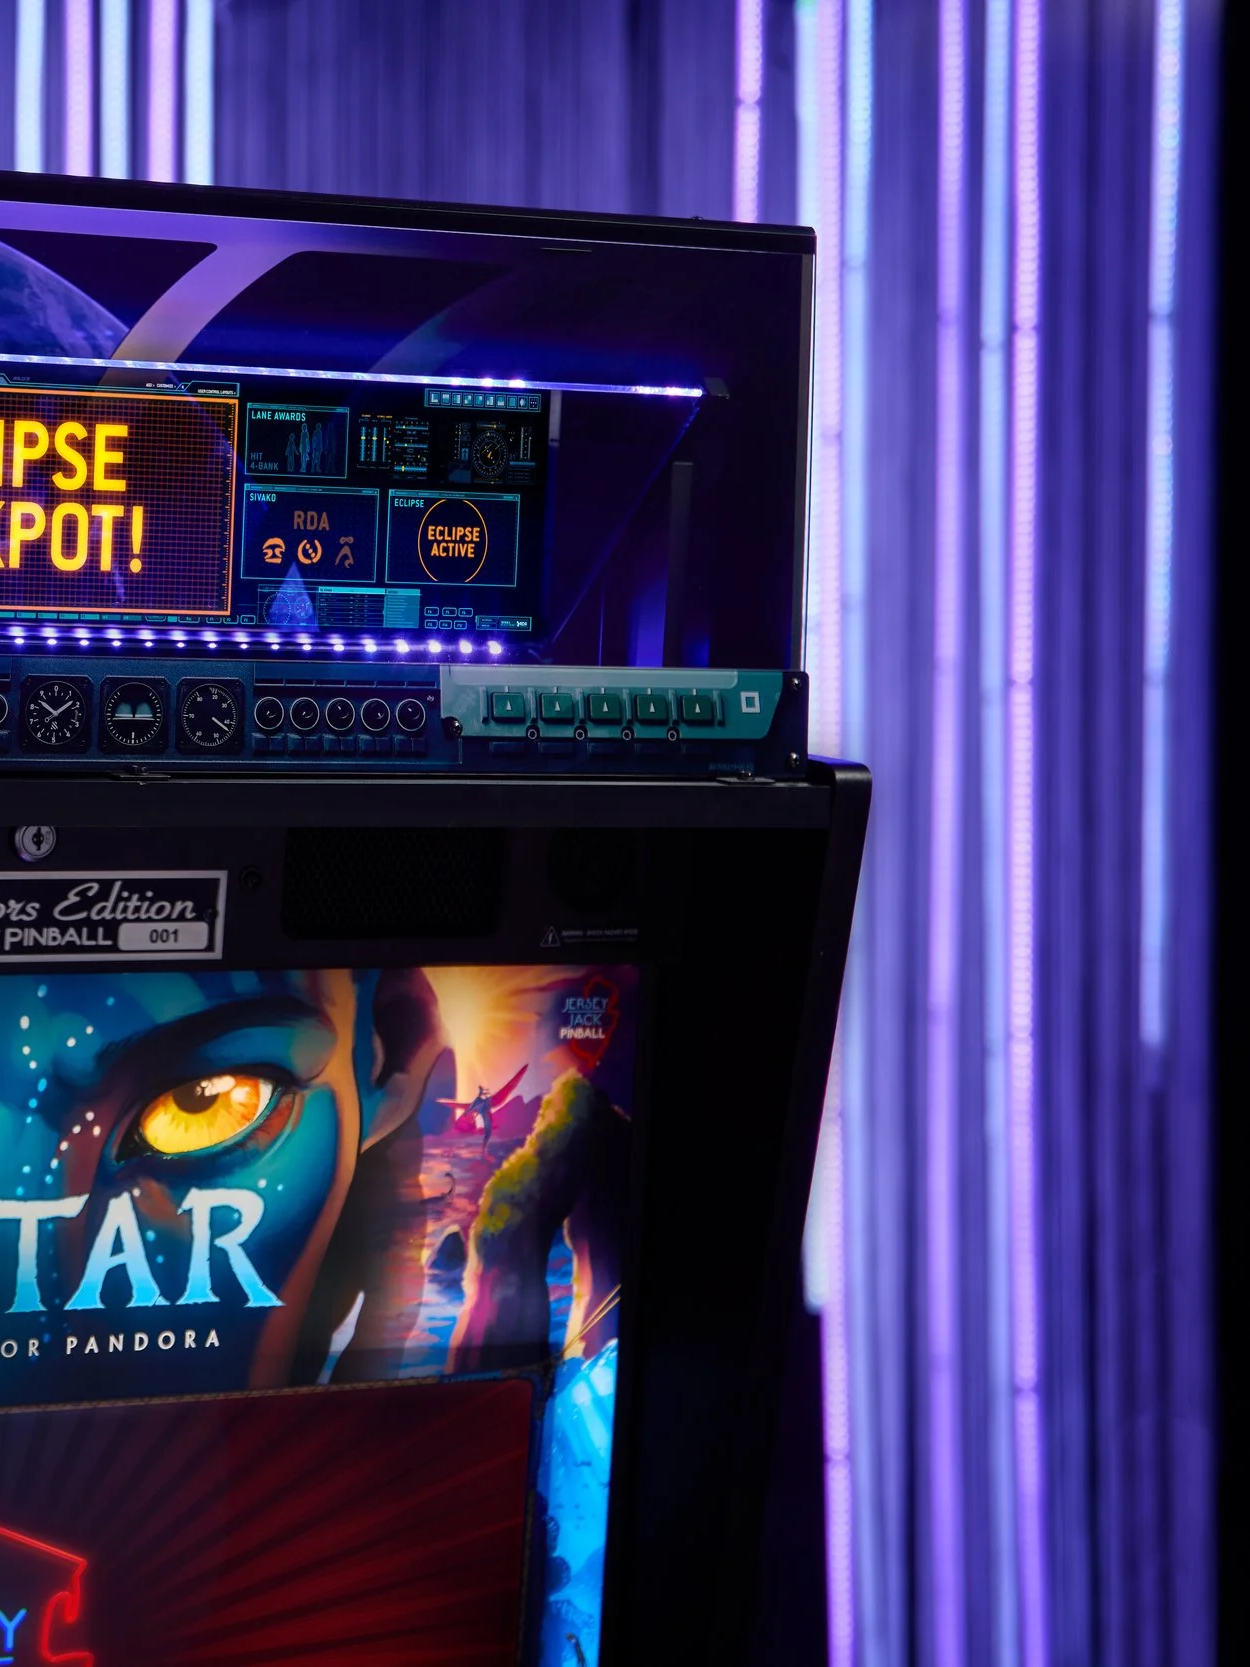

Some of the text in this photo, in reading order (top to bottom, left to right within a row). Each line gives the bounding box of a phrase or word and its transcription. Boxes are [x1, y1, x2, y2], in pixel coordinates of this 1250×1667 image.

[251, 410, 306, 422] LANE AWARDS
[250, 452, 263, 461] HIT
[250, 461, 279, 471] 4-BANK
[250, 493, 276, 502] SIVAKO
[394, 498, 425, 508] ECLIPSE
[293, 510, 330, 531] RDA
[427, 525, 481, 542] ECLIPSE
[430, 542, 475, 558] ACTIVE
[53, 881, 196, 921] Edition
[4, 926, 113, 951] PINBALL
[149, 929, 179, 944] 001
[562, 998, 609, 1013] JERSEY
[568, 1014, 602, 1028] JACK
[559, 1028, 605, 1040] PINBALL
[65, 1328, 222, 1356] PANDORA
